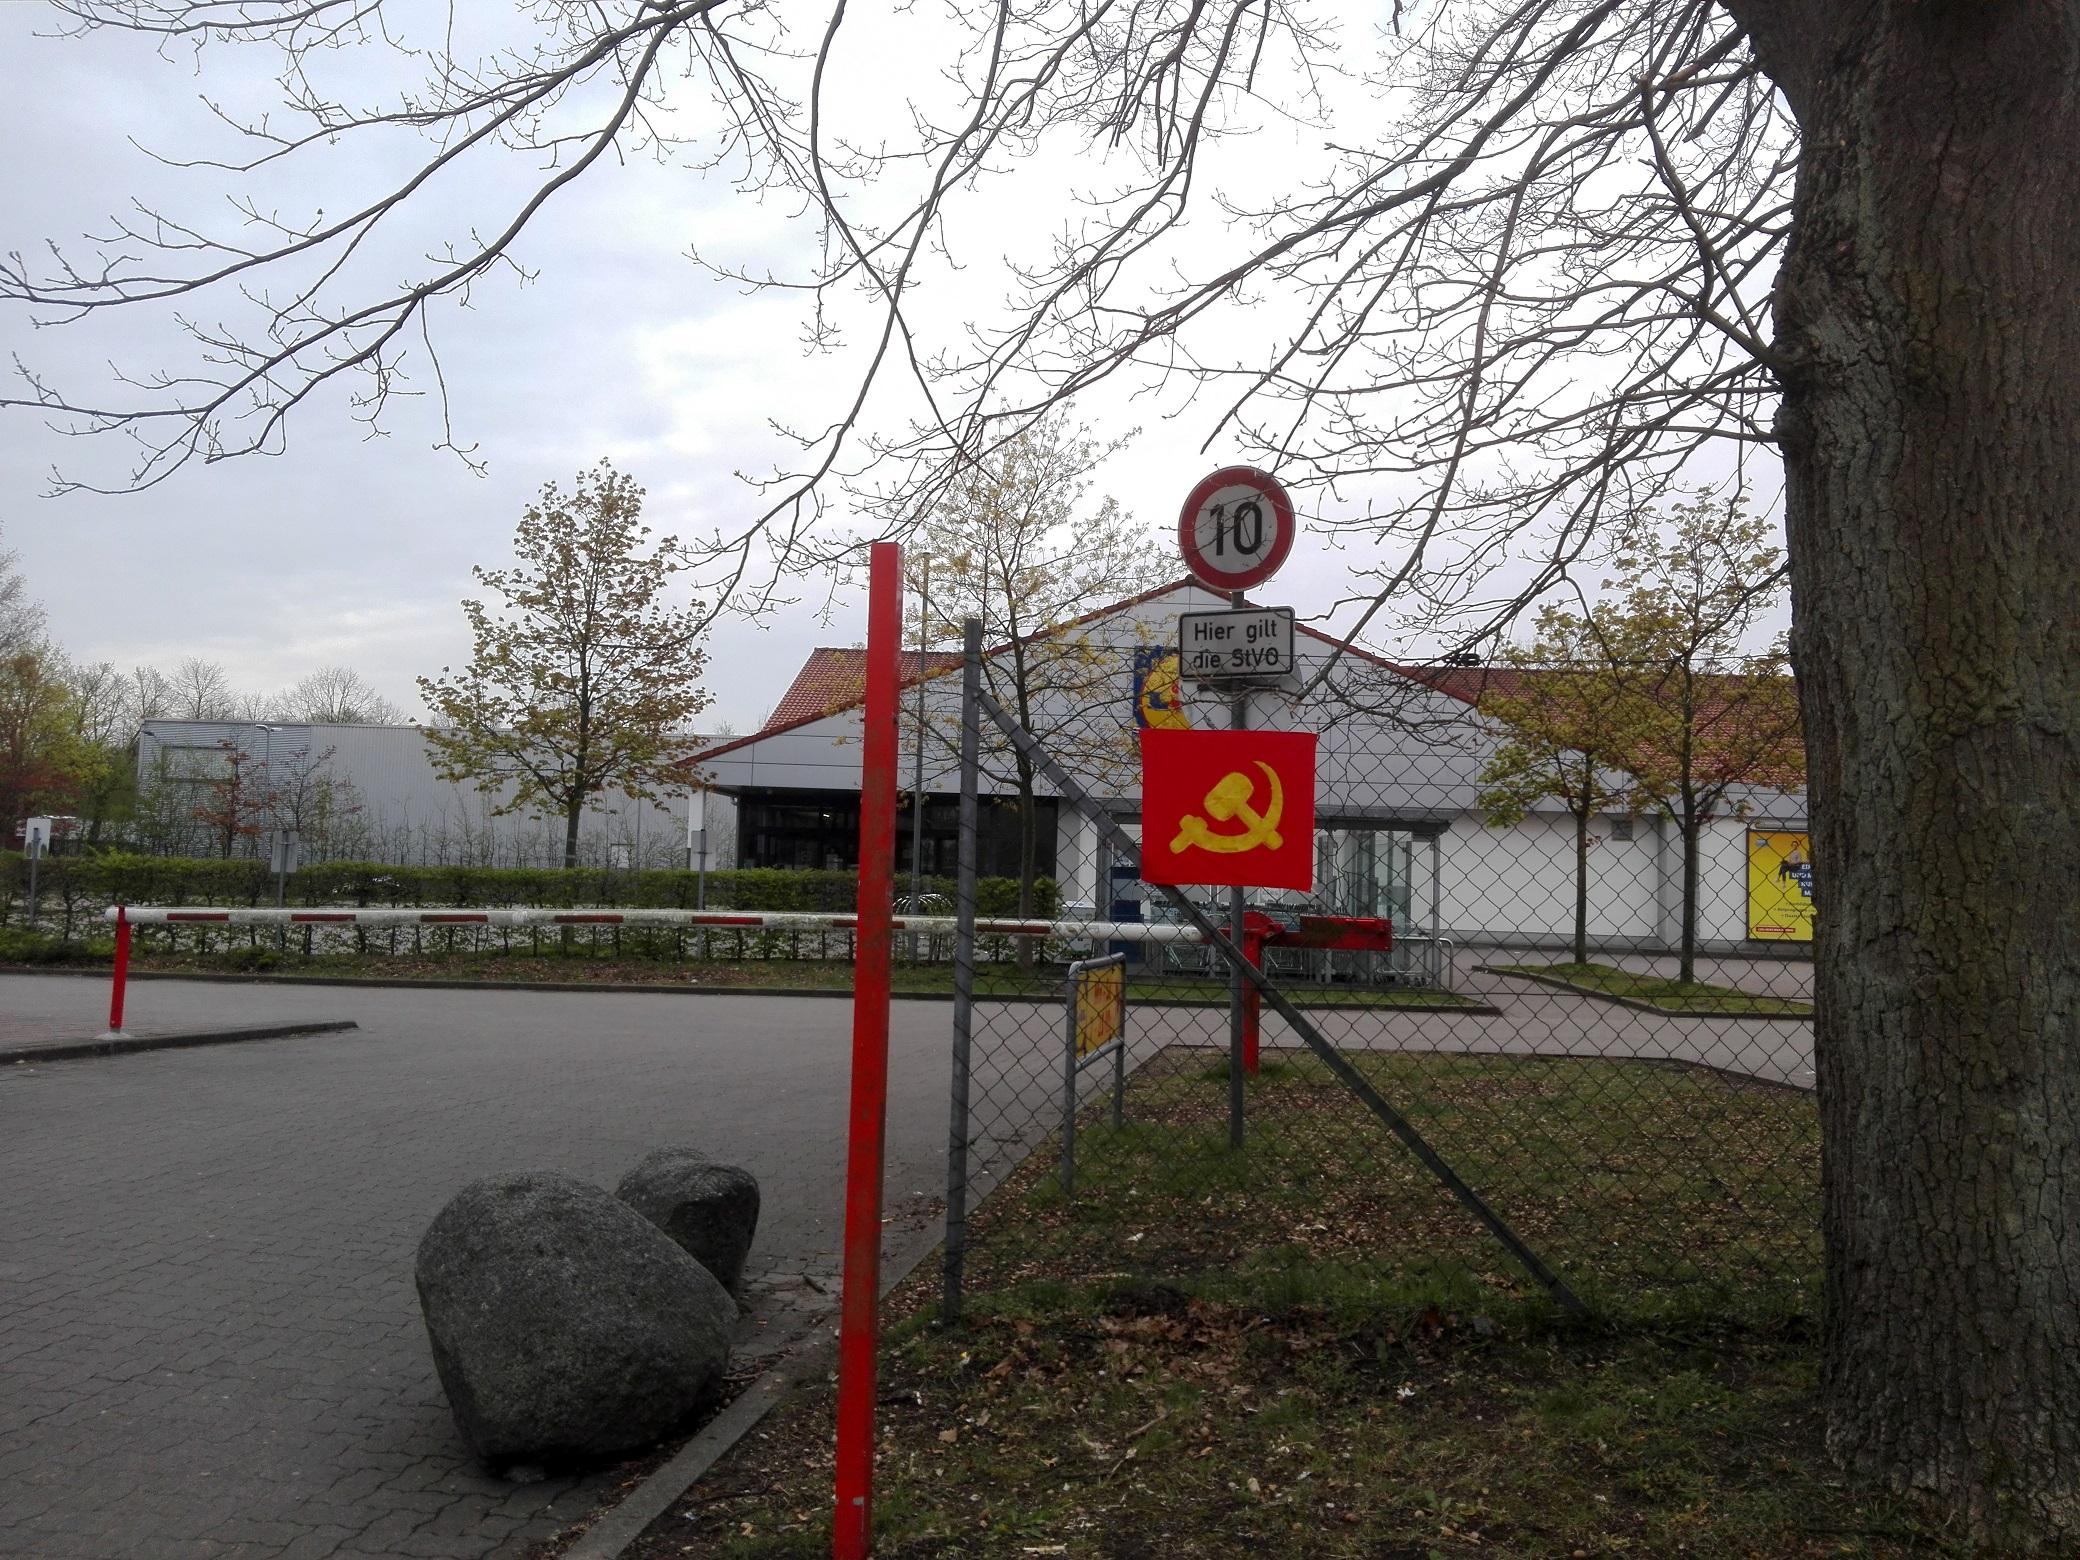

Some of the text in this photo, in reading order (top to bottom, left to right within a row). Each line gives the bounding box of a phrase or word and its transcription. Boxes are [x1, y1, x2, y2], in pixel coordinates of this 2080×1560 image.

[1209, 501, 1262, 556] 10
[1194, 619, 1277, 643] Hier gilt
[1193, 647, 1278, 668] die StVO
